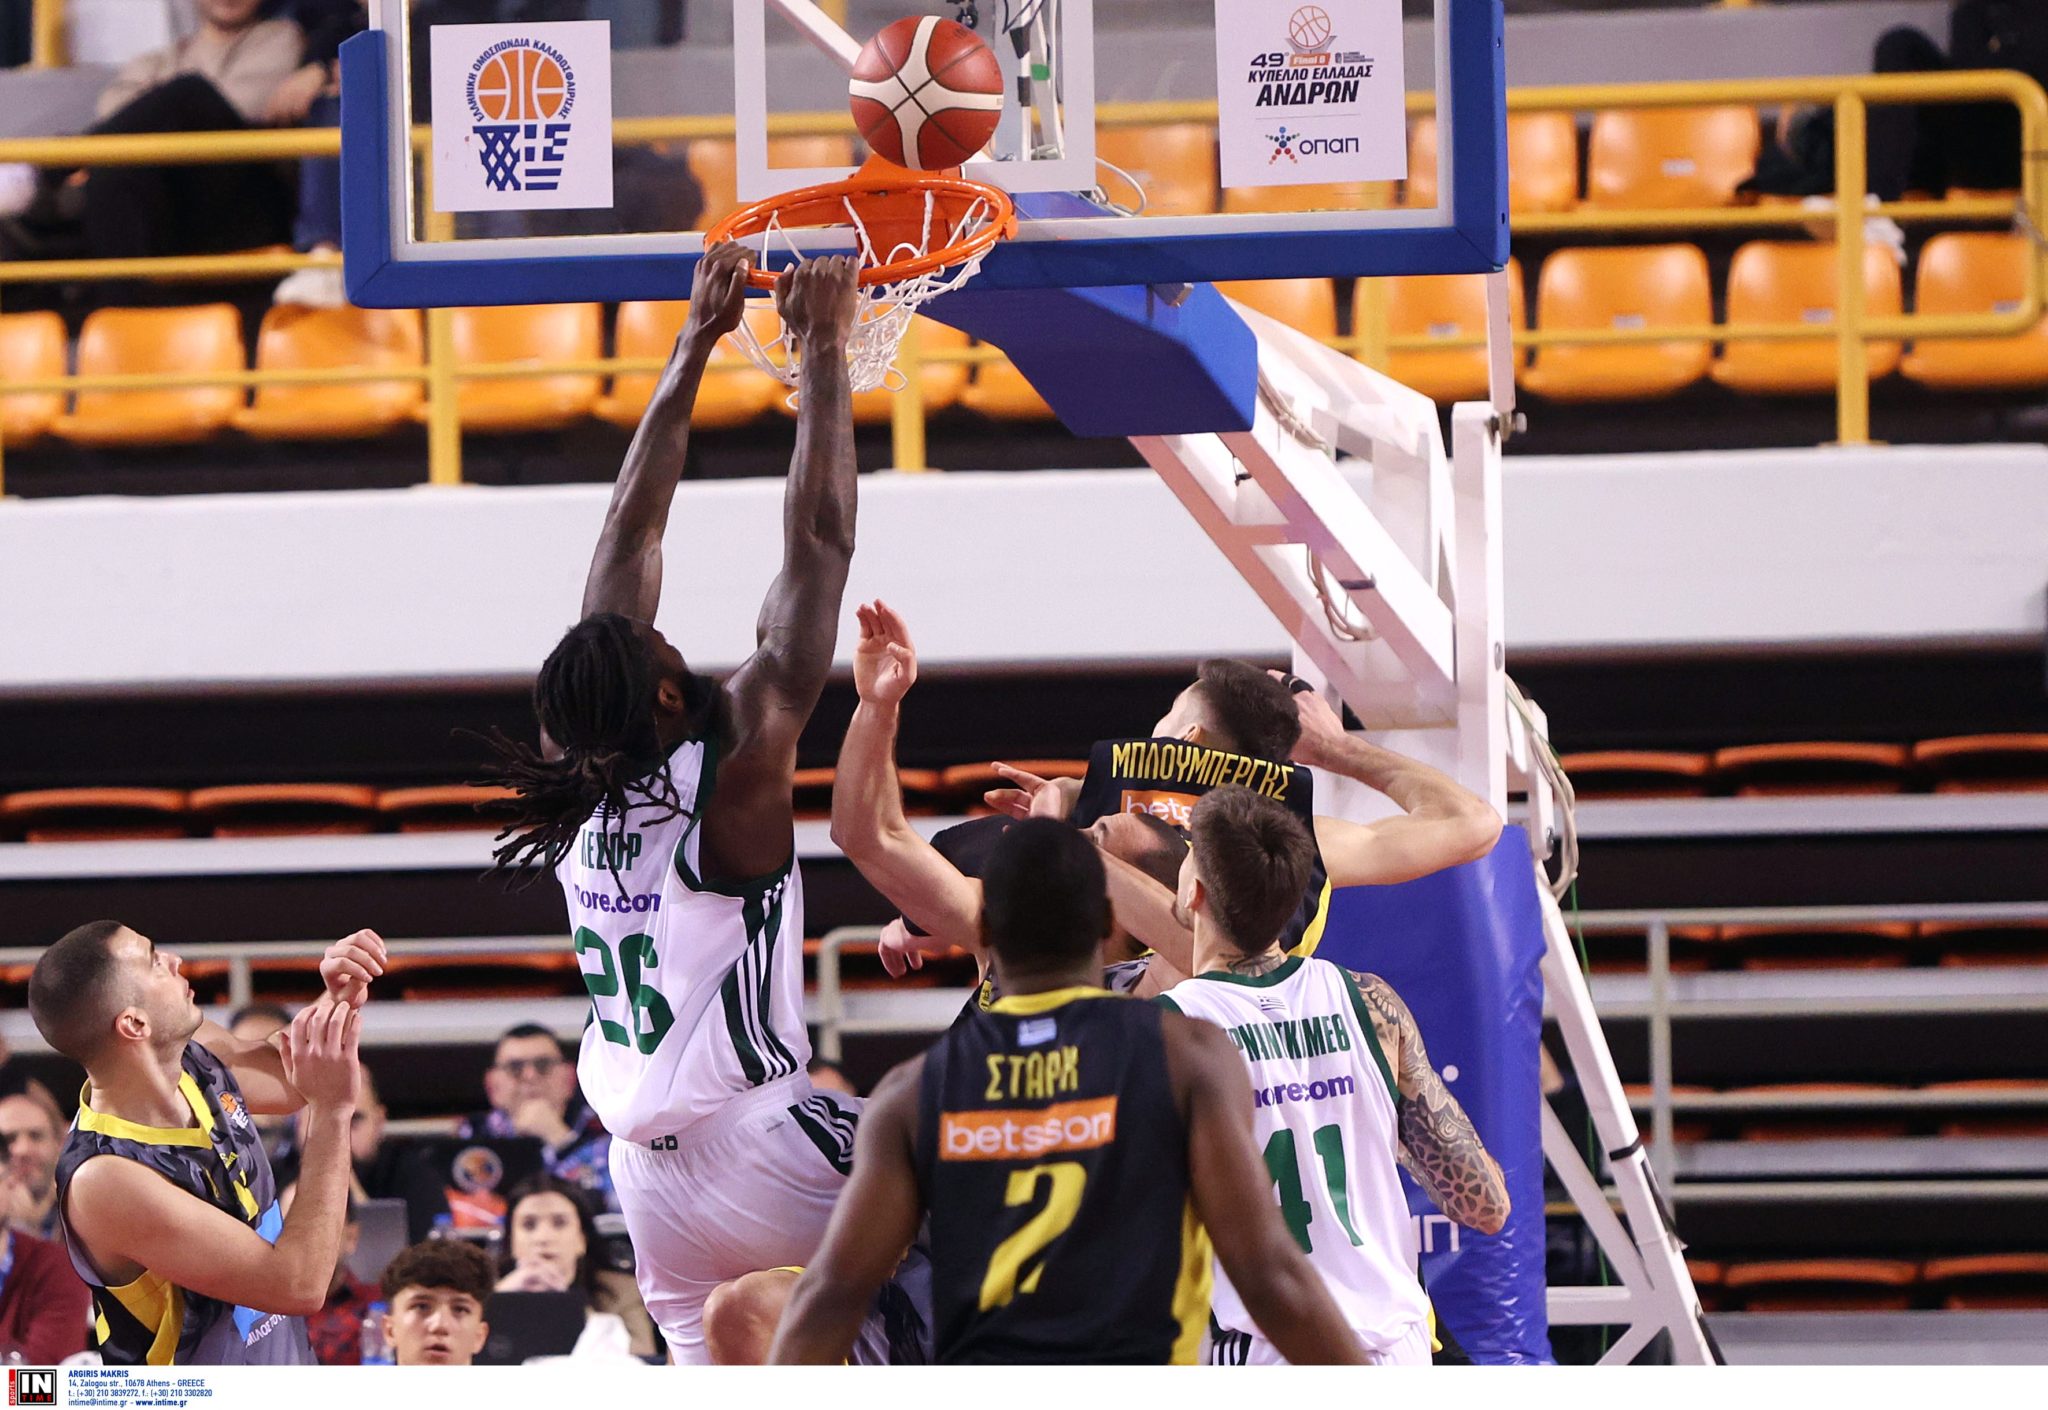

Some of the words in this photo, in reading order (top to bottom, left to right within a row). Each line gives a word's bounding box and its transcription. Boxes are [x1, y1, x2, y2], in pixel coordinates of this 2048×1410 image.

[473, 38, 530, 72] ΟΜΟΣΠΟΝΔΙΑ
[533, 39, 576, 120] ΚΑΛΑΘΟΣΦΑΙΡΙΣΗΣ
[1248, 68, 1309, 83] ΚΥΠΕΛΛΟ
[1312, 65, 1373, 80] ΕΛΛΑΔΑΣ
[466, 73, 485, 122] ΕΛΛΗΝΙΚΗ
[1255, 80, 1360, 107] ΑΝΔΡΩΝ
[1112, 742, 1295, 801] ΜΠΛΟΥΜΠΕΡΓΚΣ
[1126, 795, 1194, 825] bets
[574, 925, 676, 1055] 26
[984, 1046, 1080, 1100] ΣΤΑΡΚ
[946, 1110, 1112, 1154] betsson
[1262, 1123, 1364, 1254] 41
[978, 1161, 1087, 1313] 2
